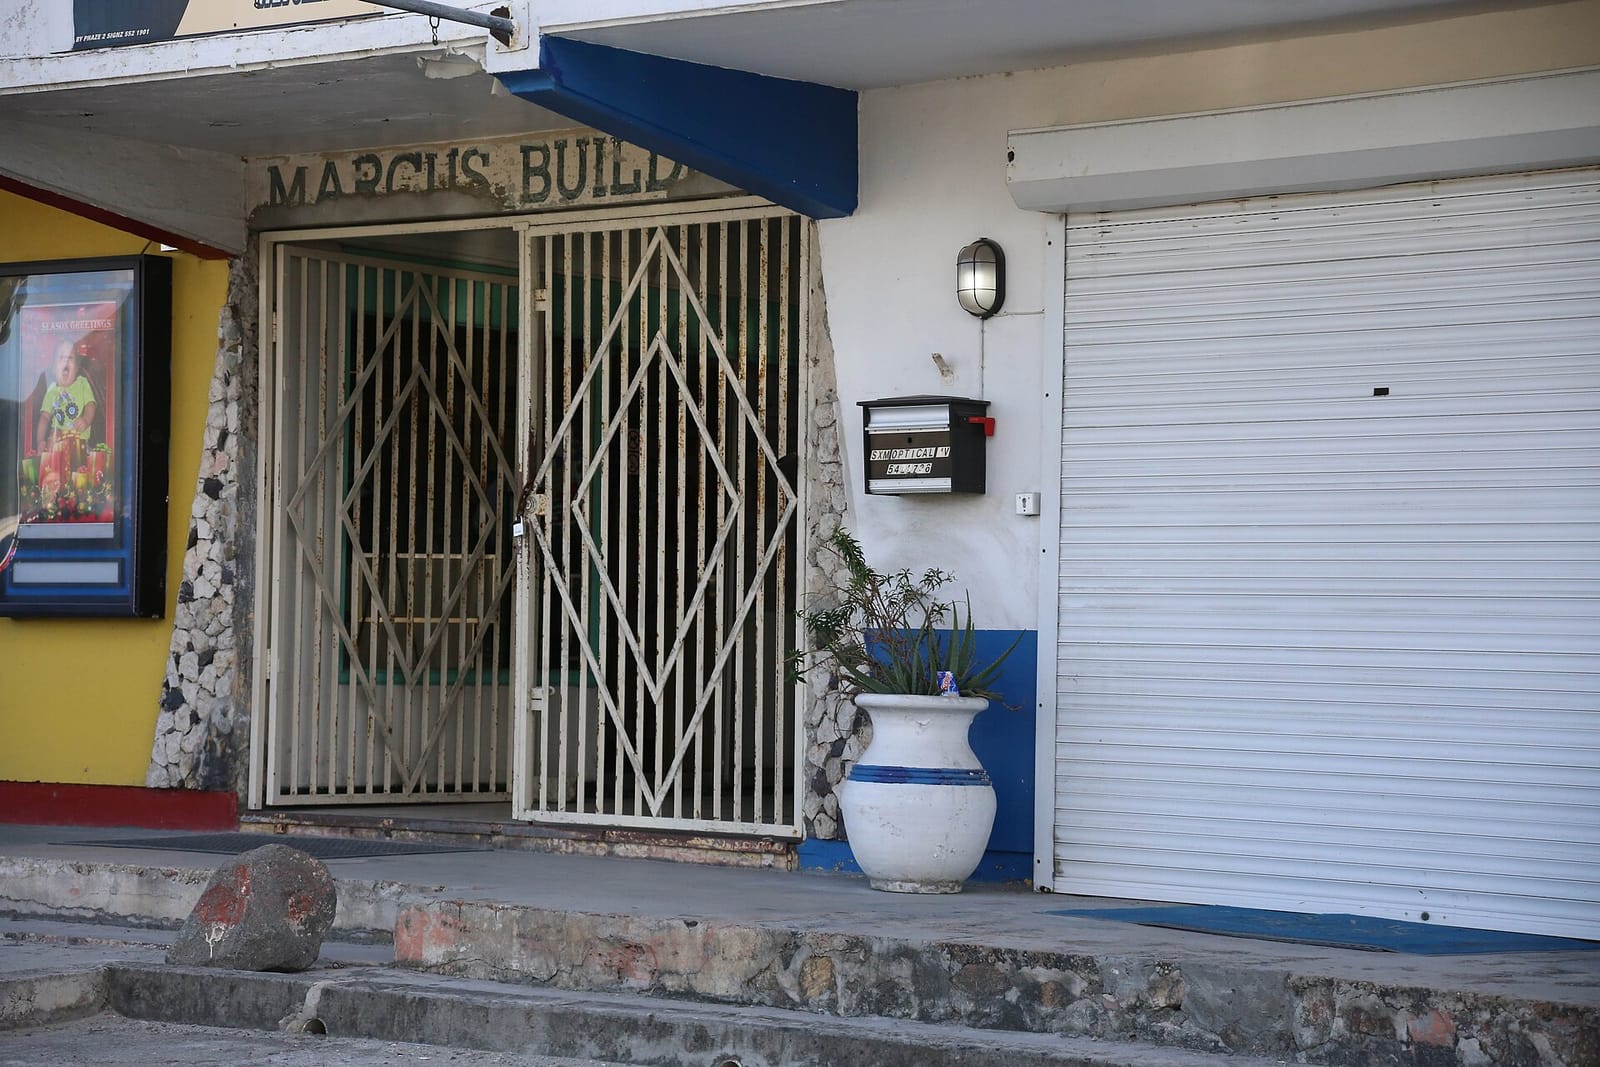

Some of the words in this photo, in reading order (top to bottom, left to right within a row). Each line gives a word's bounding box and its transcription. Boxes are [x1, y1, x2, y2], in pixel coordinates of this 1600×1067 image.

[70, 319, 112, 329] GREETINGS
[871, 450, 891, 460] SXM
[891, 447, 935, 459] OPTICAL
